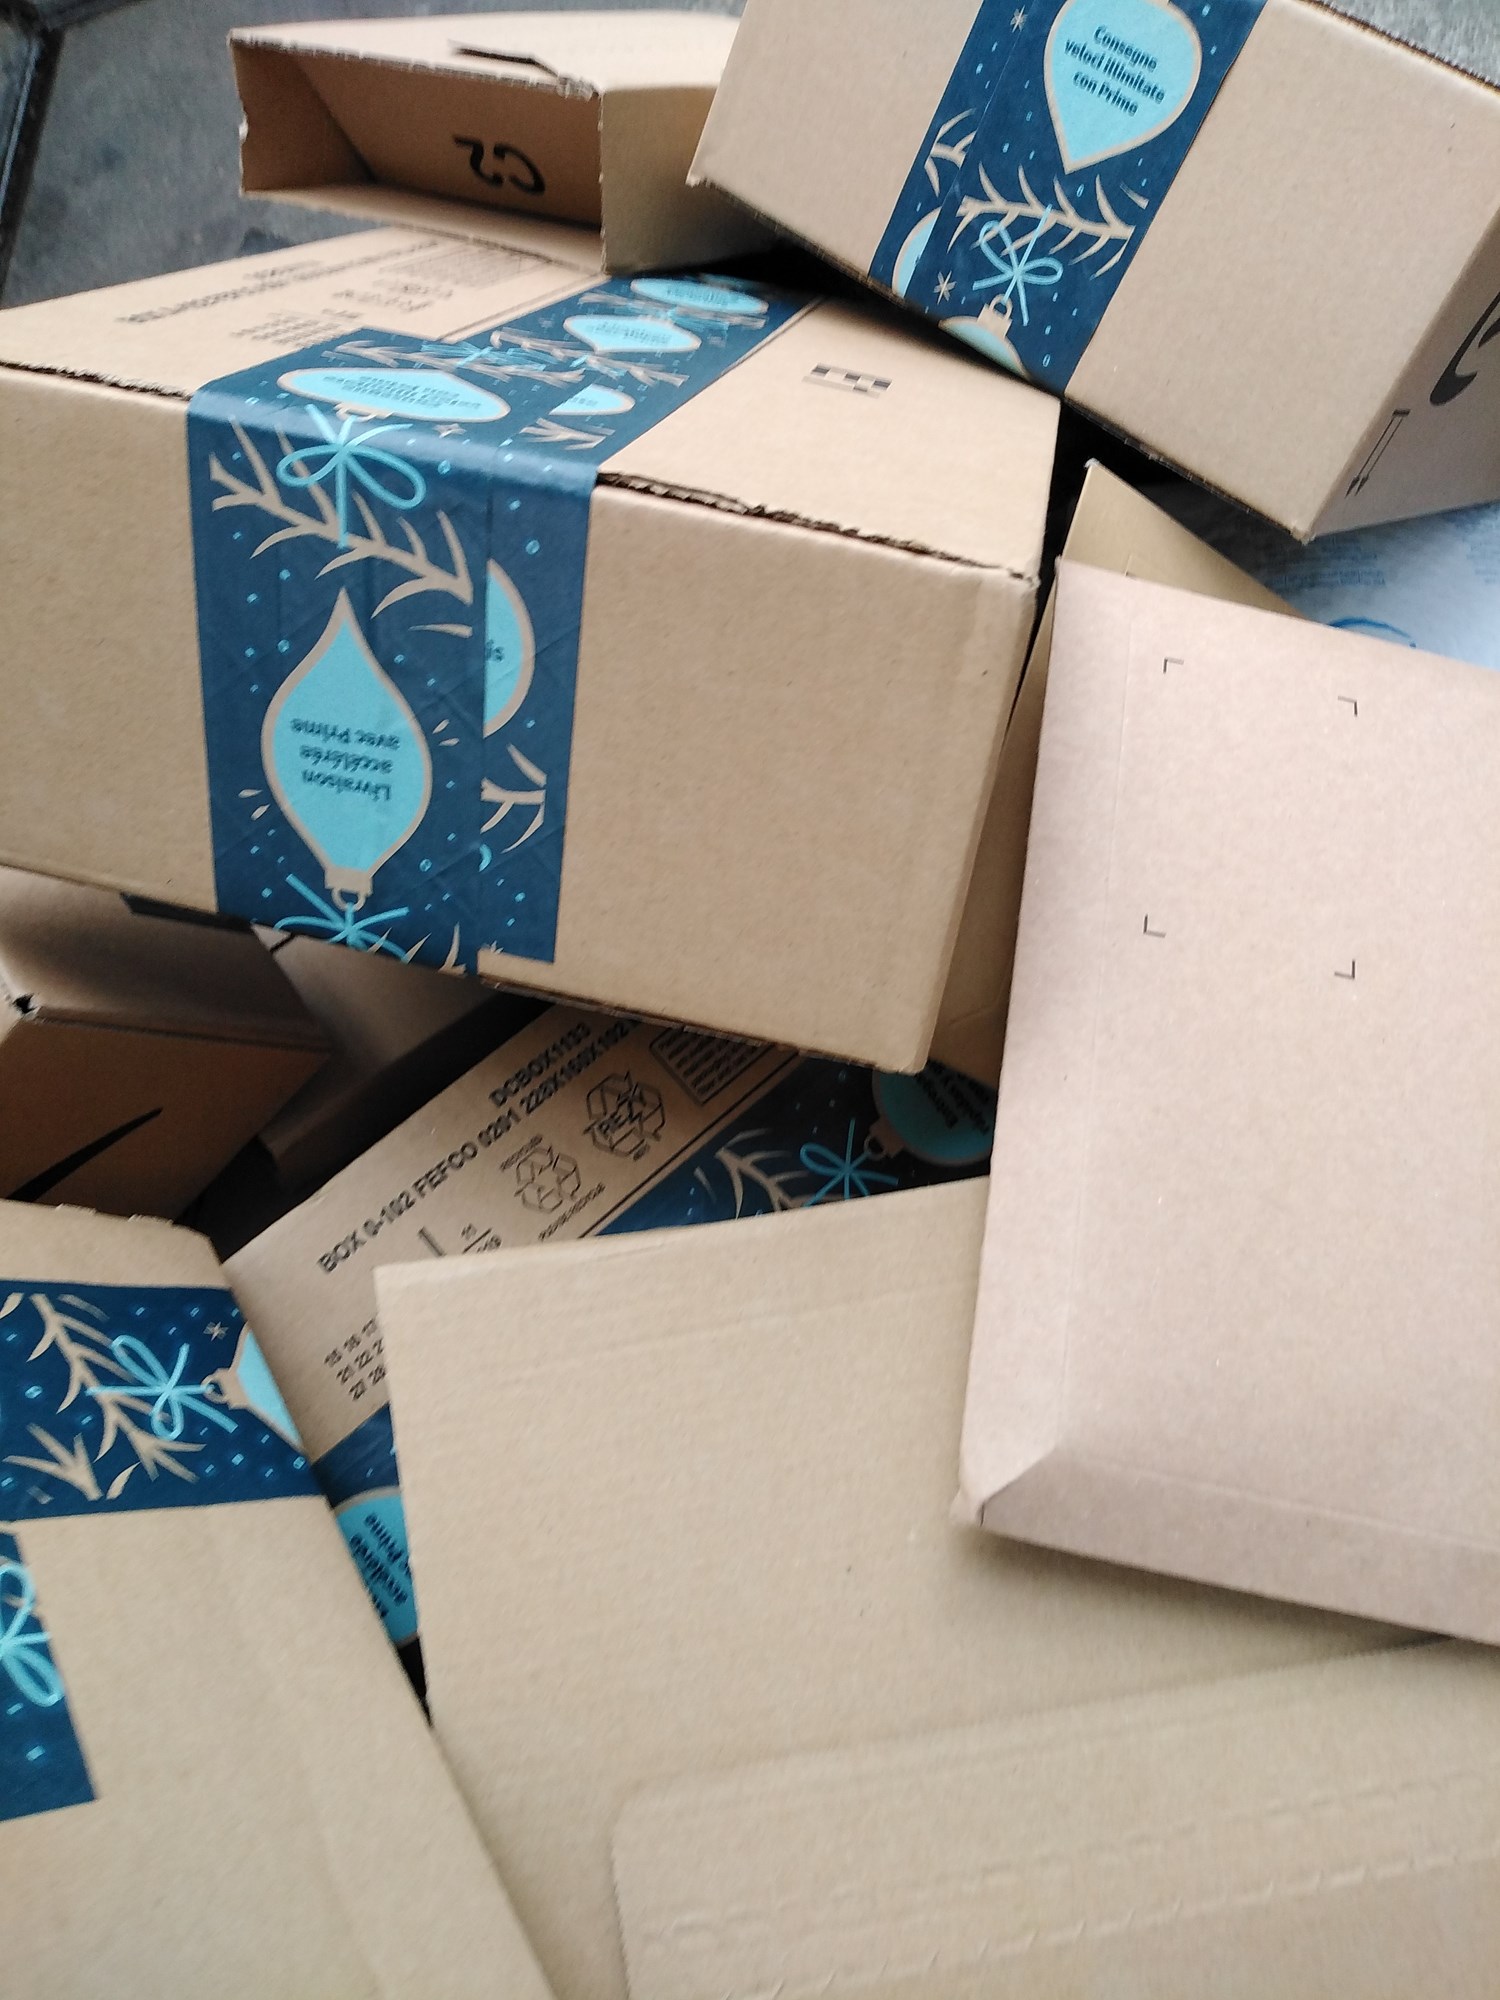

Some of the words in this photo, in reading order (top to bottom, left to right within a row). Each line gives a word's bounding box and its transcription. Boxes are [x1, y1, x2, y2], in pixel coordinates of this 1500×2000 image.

[1093, 25, 1158, 73] Consegne
[1073, 71, 1098, 95] con
[1097, 81, 1138, 117] Prime
[1103, 54, 1165, 105] illimitate
[291, 718, 350, 745] Prime
[354, 728, 400, 751] avec
[302, 770, 391, 802] Livraison
[317, 1229, 367, 1274] BOX
[412, 1140, 478, 1199] FEFCO
